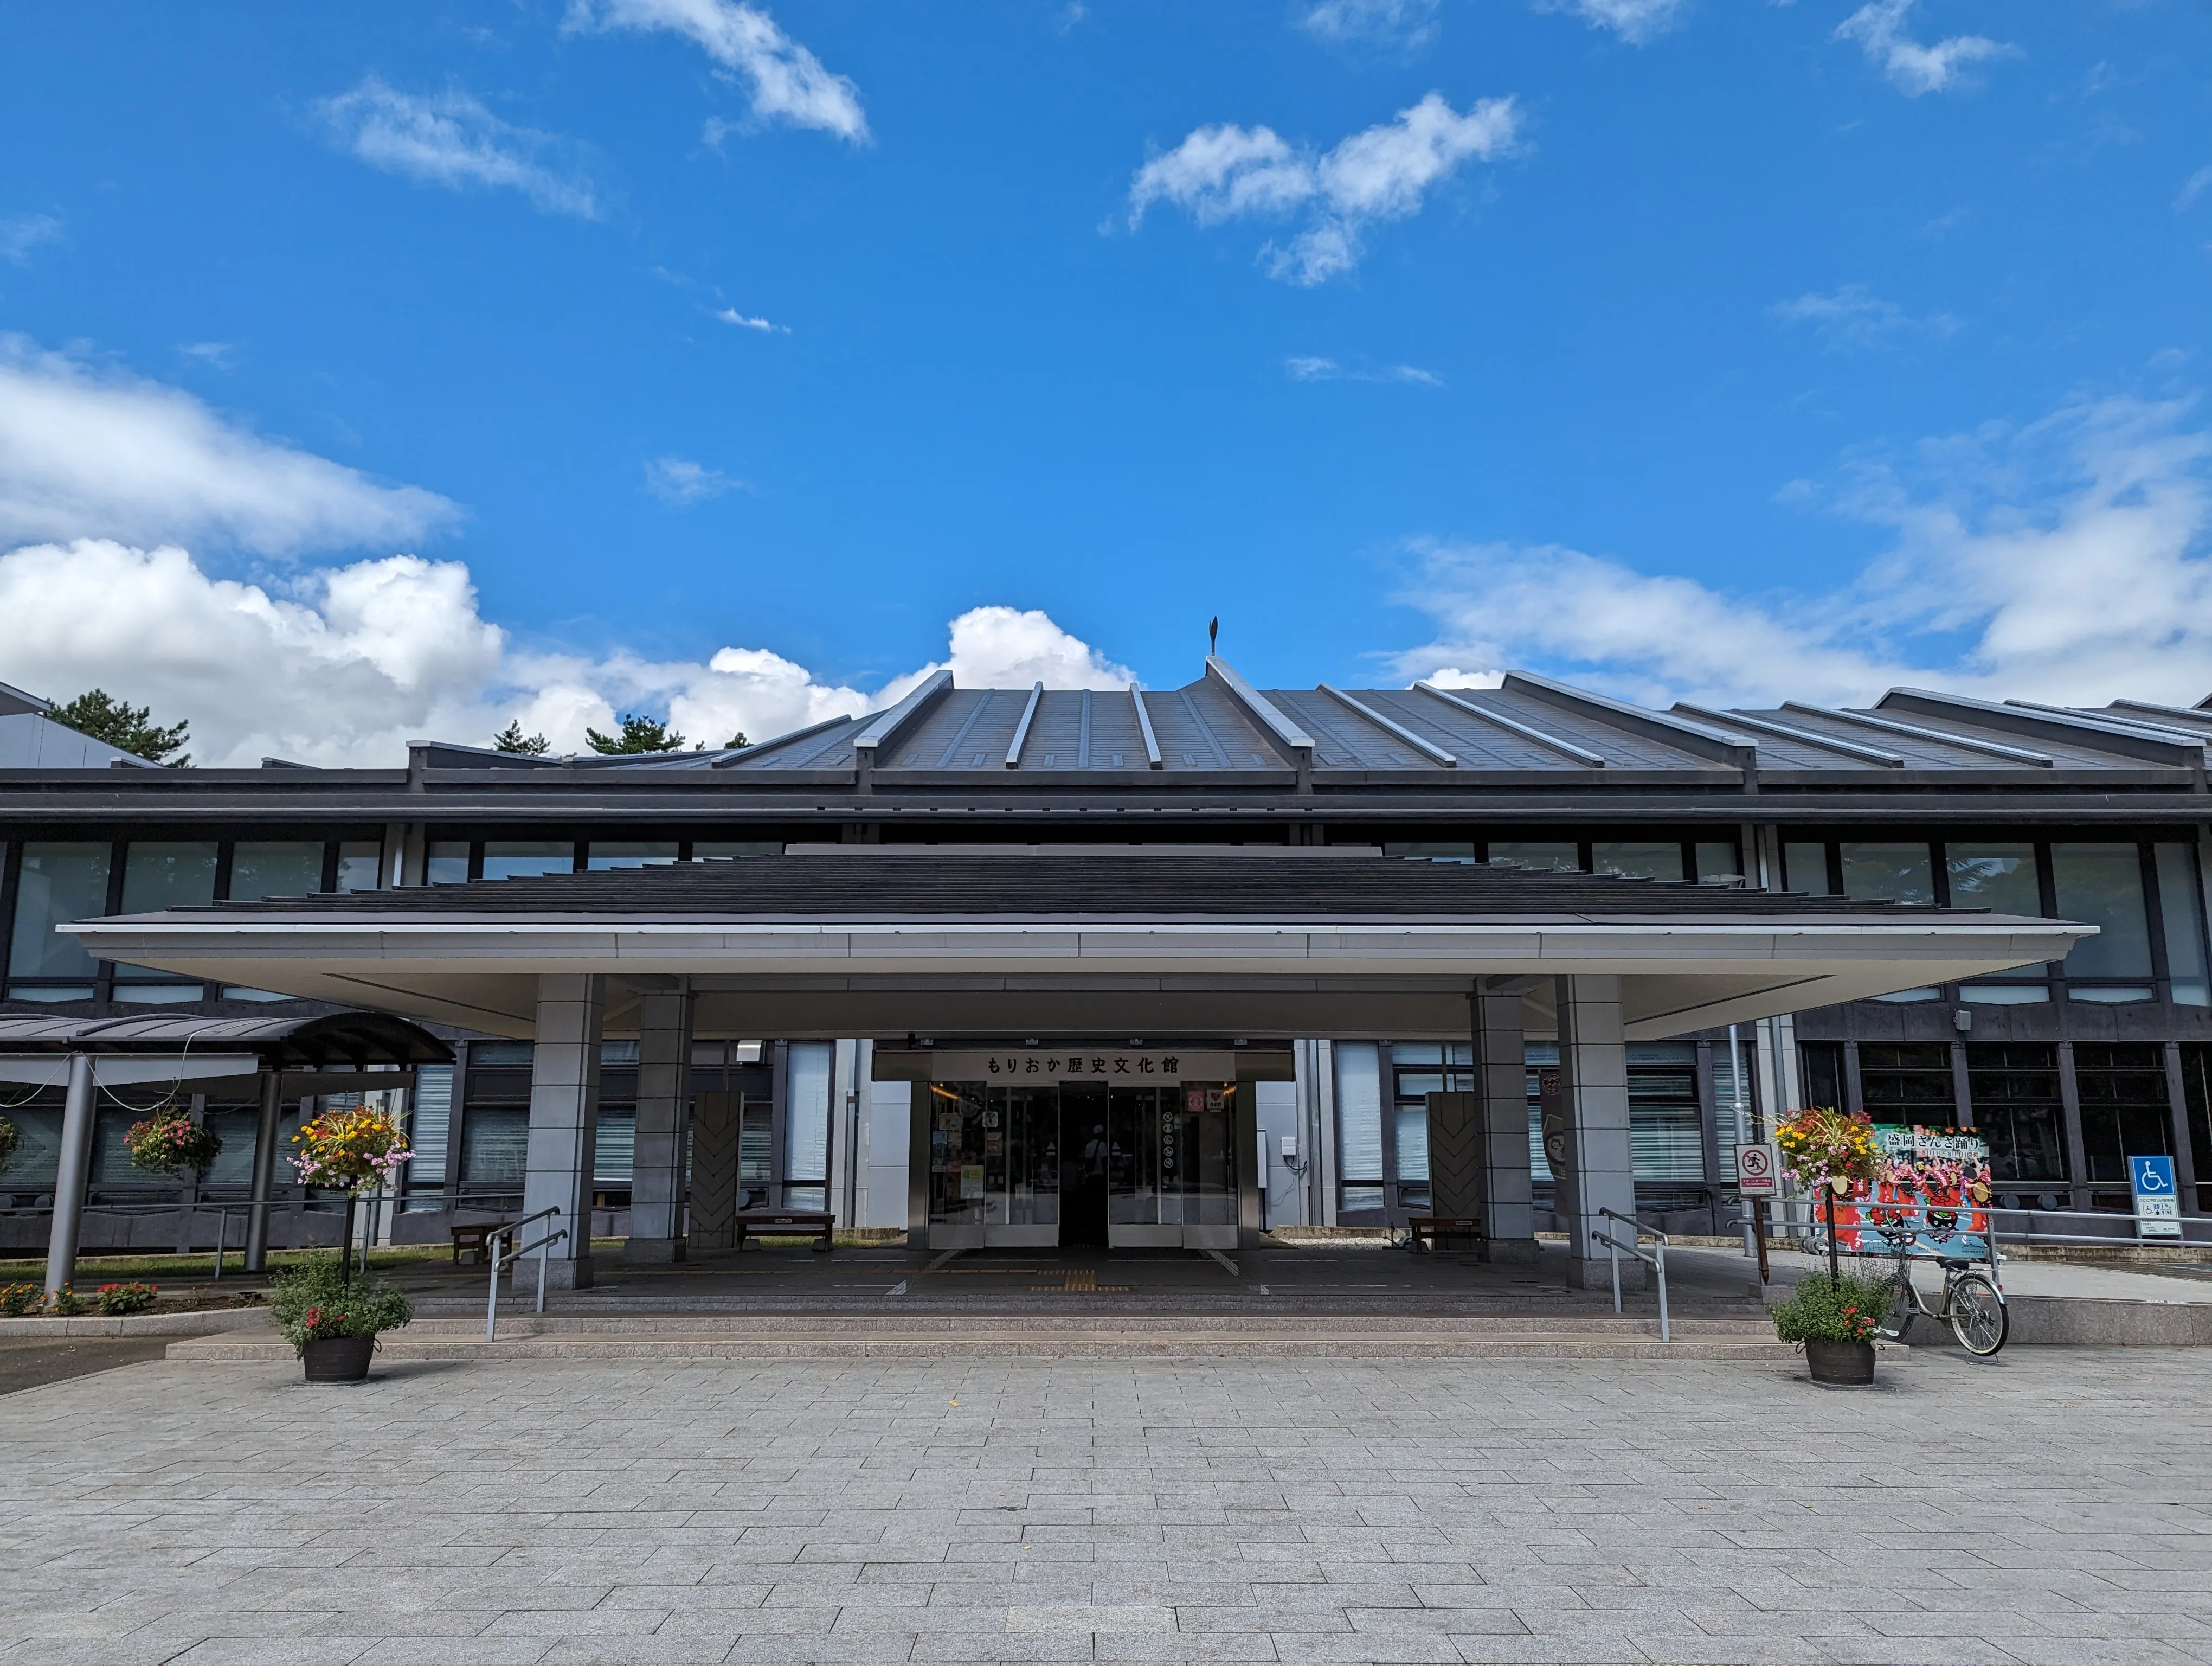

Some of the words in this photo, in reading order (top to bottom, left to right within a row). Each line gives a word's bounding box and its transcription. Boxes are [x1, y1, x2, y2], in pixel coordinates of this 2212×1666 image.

[987, 1056, 1179, 1074] もりおか歴史文化館
[1887, 1133, 1979, 1150] 盛岡さんさ踊り
